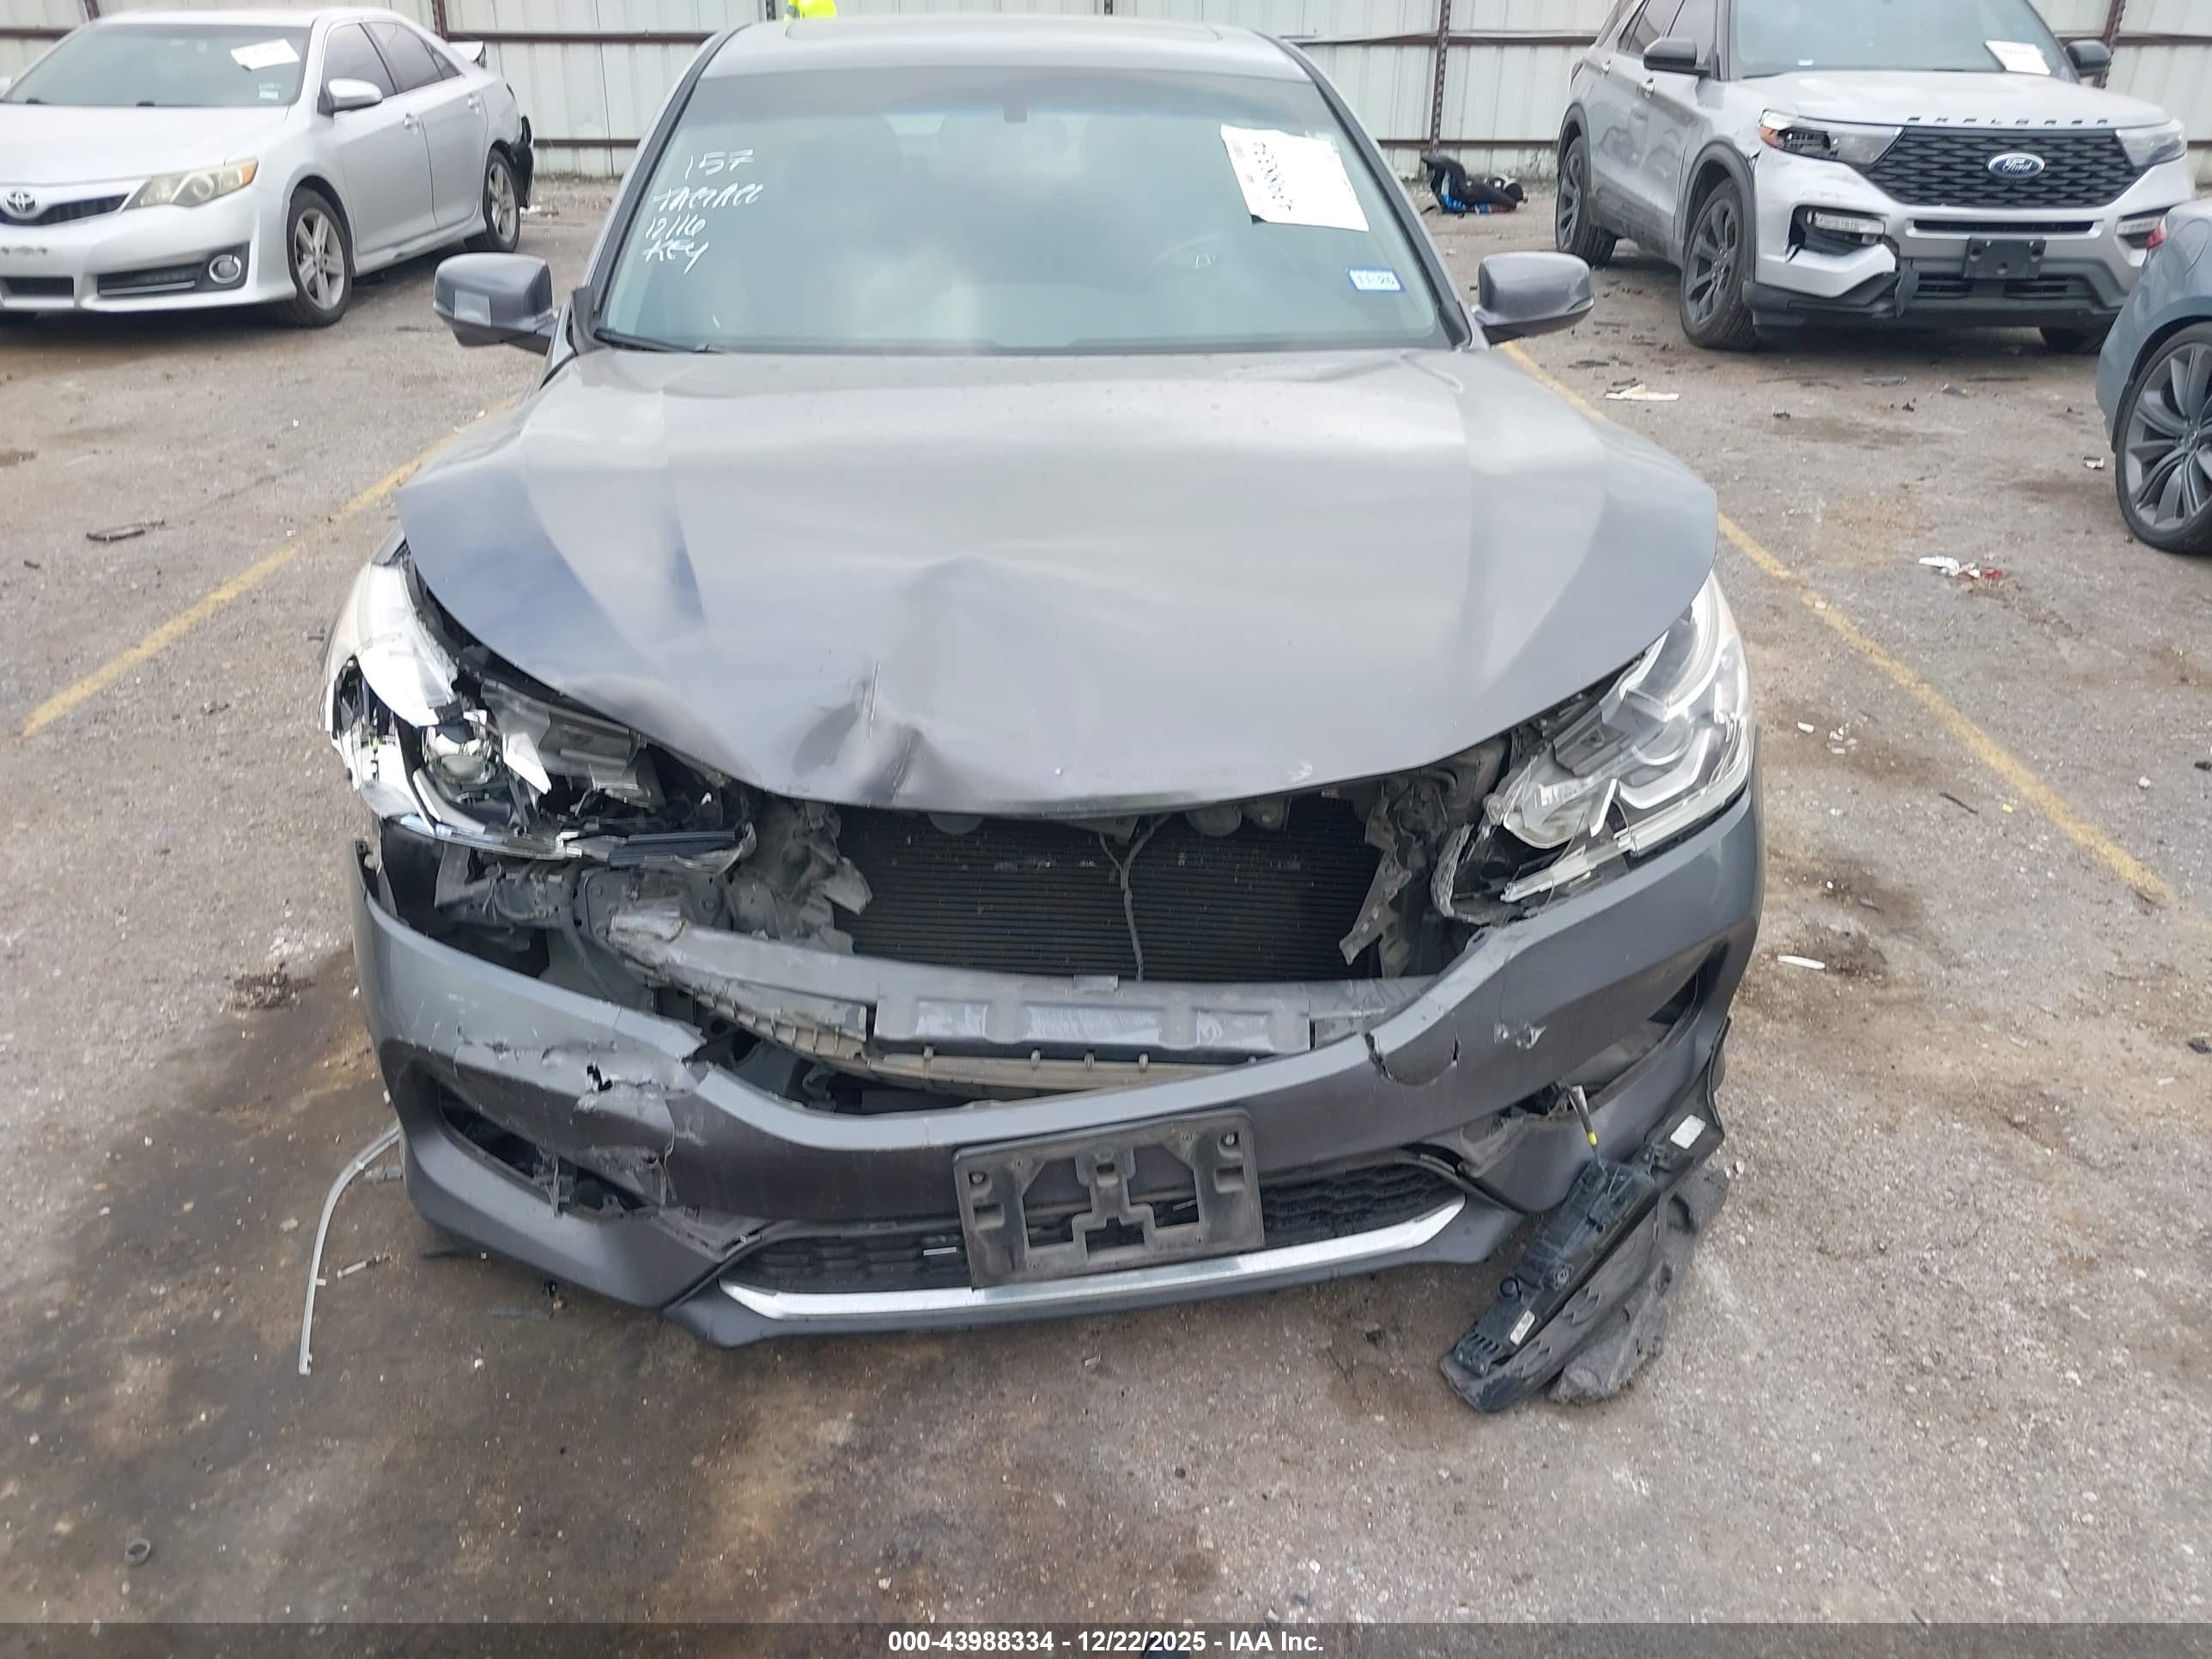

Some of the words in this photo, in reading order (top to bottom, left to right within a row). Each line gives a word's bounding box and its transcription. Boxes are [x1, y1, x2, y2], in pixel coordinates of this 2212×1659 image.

[684, 149, 754, 179] 157
[2001, 157, 2033, 173] Ford
[642, 239, 709, 275] KEY
